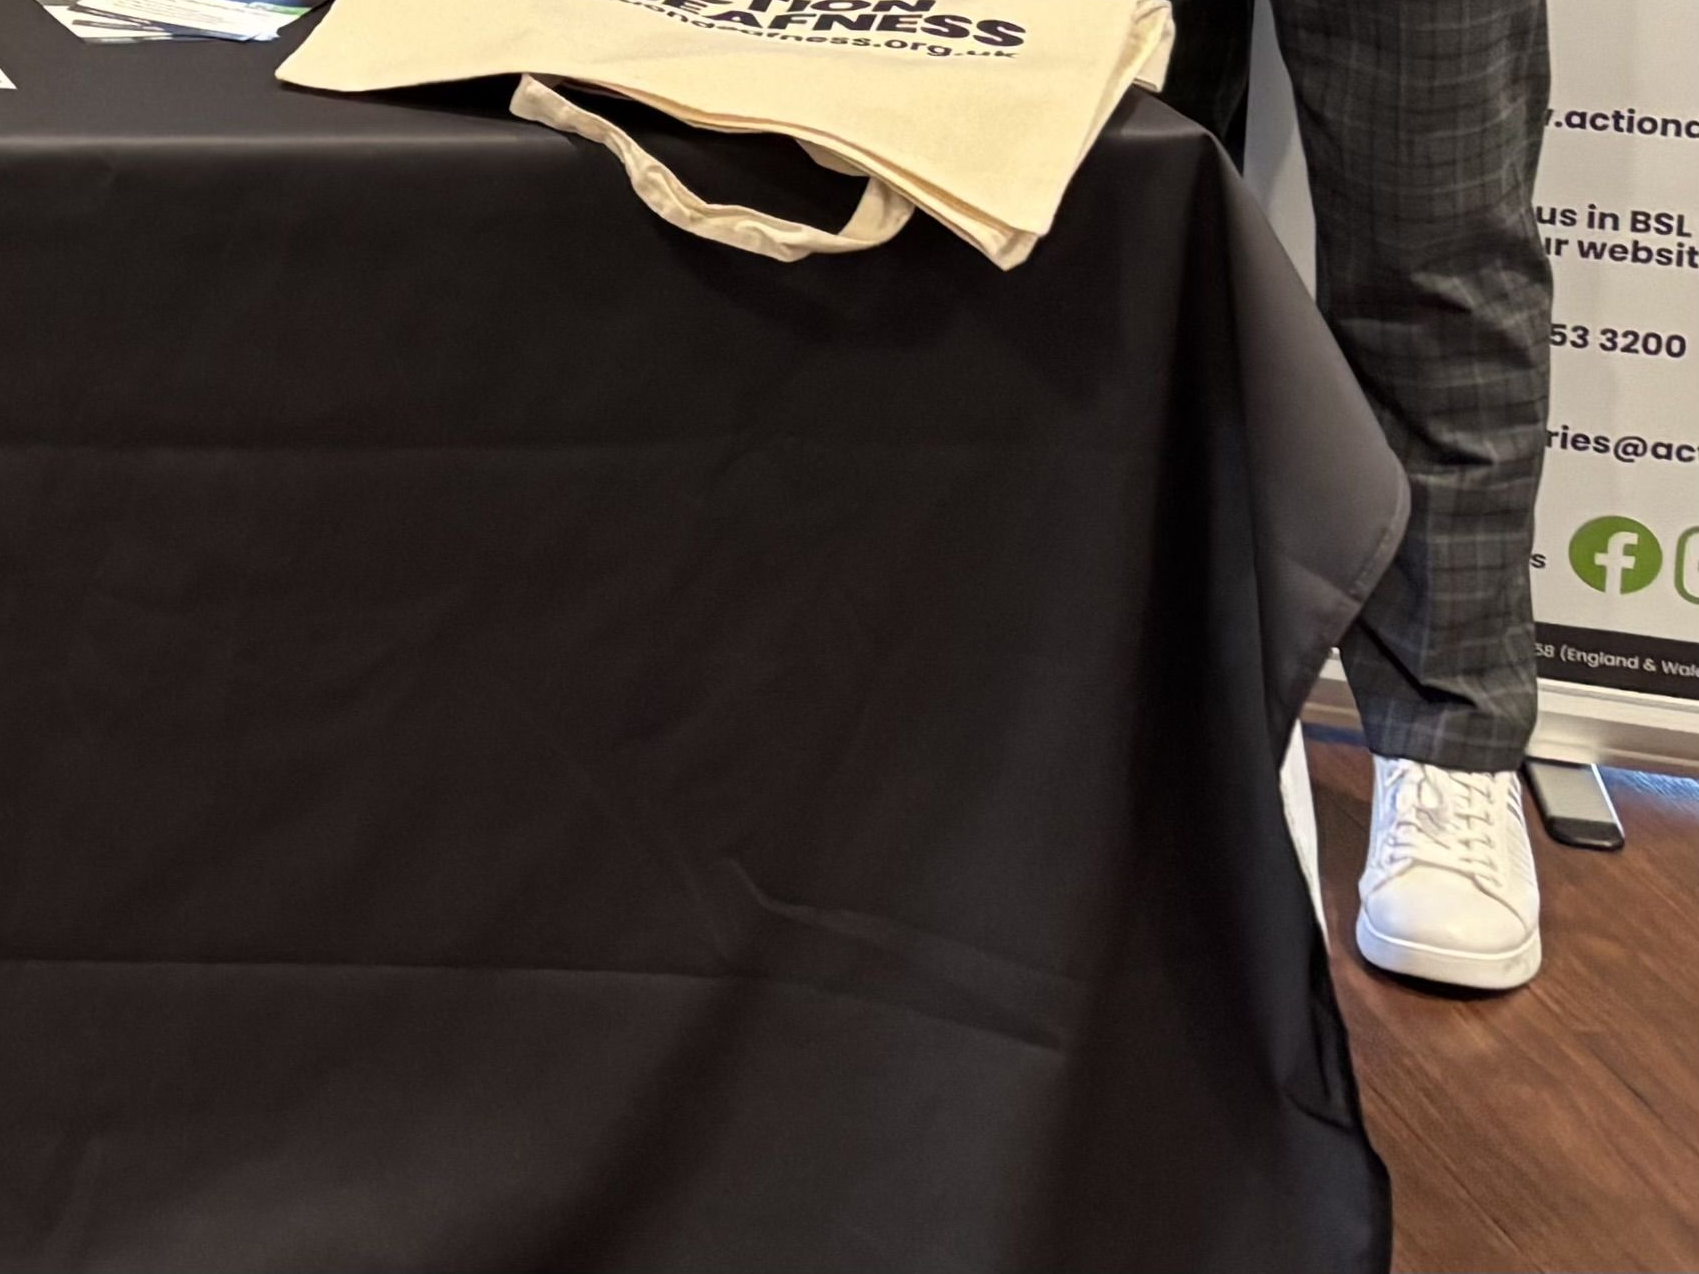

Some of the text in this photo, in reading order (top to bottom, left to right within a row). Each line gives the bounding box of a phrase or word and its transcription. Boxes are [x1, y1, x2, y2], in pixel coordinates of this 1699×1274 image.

[1586, 204, 1620, 231] in
[1630, 210, 1692, 238] BSL
[1599, 327, 1687, 358] 3200
[1642, 657, 1656, 671] &
